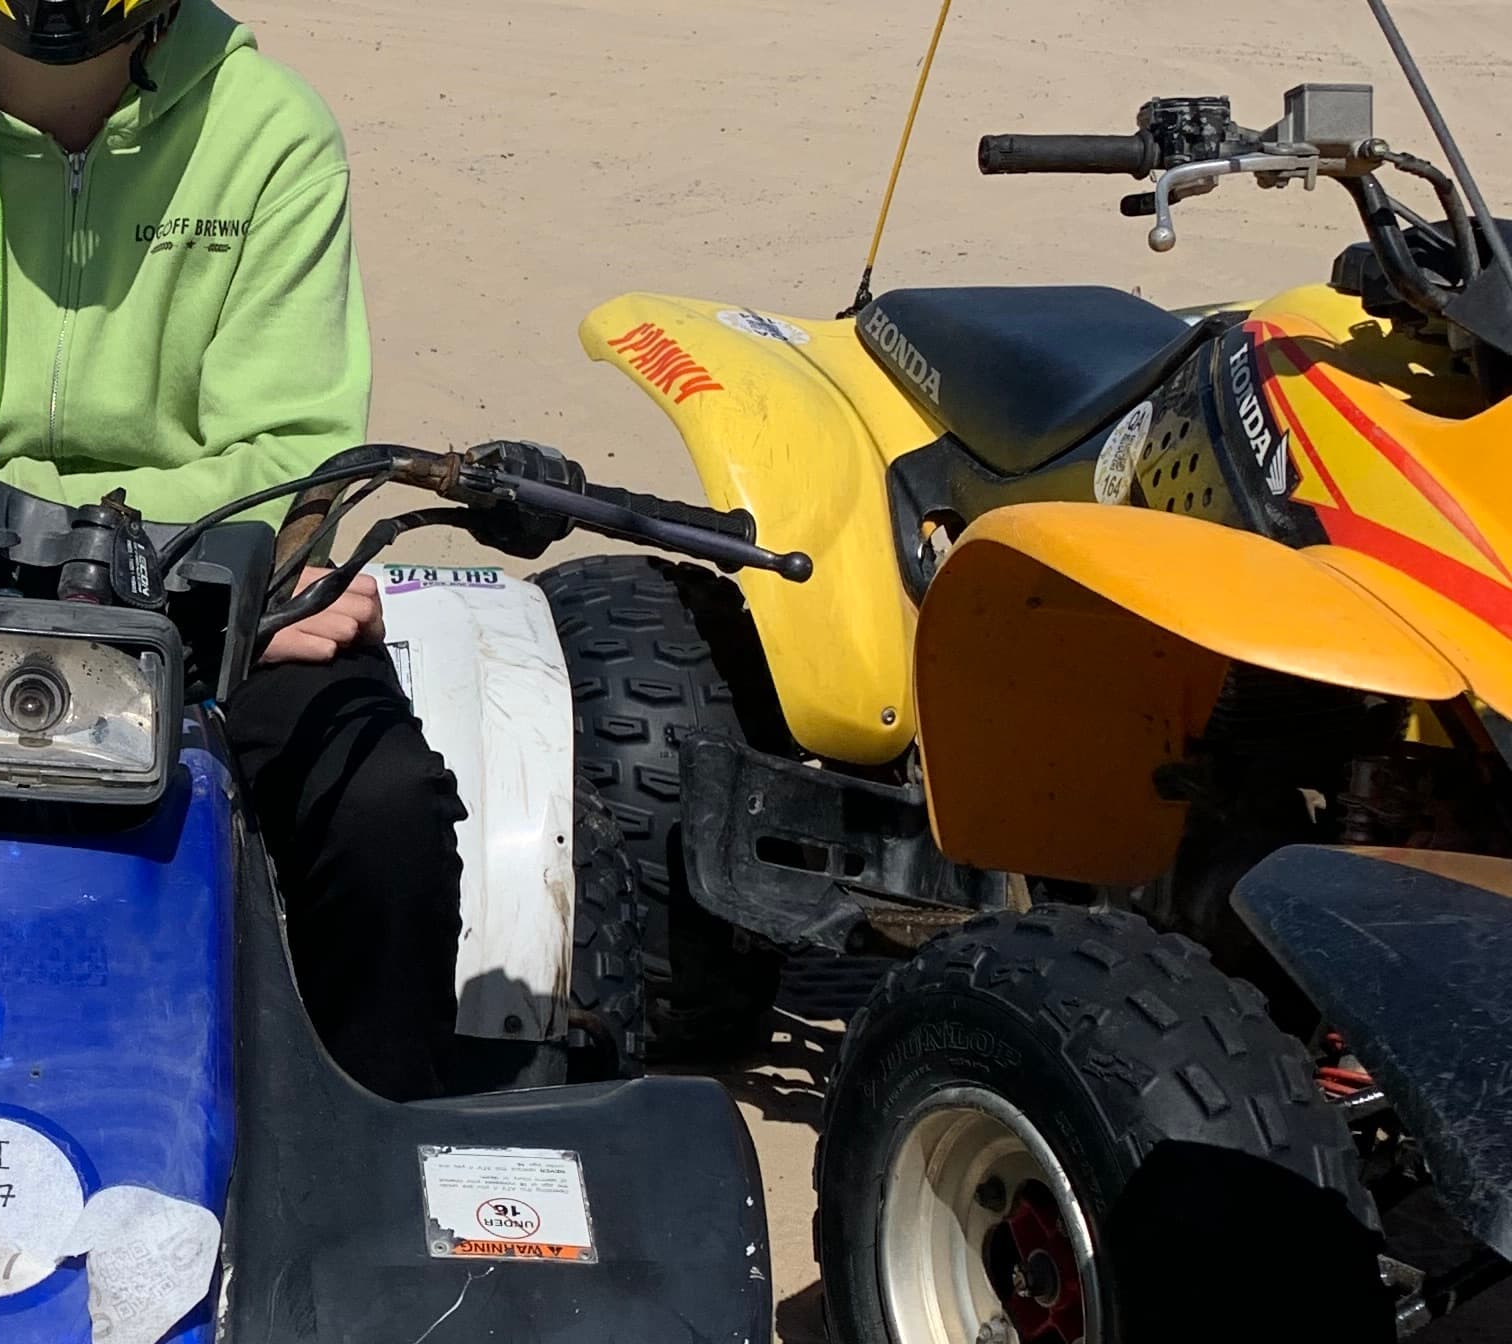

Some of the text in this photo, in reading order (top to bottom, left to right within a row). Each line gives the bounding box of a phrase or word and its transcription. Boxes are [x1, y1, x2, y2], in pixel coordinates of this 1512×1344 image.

[607, 322, 724, 405] SPANKY
[865, 307, 942, 405] HONDA
[1229, 342, 1272, 467] HONDA
[483, 1218, 534, 1230] UNDER
[493, 1204, 521, 1217] 16
[461, 1242, 543, 1257] WARNING
